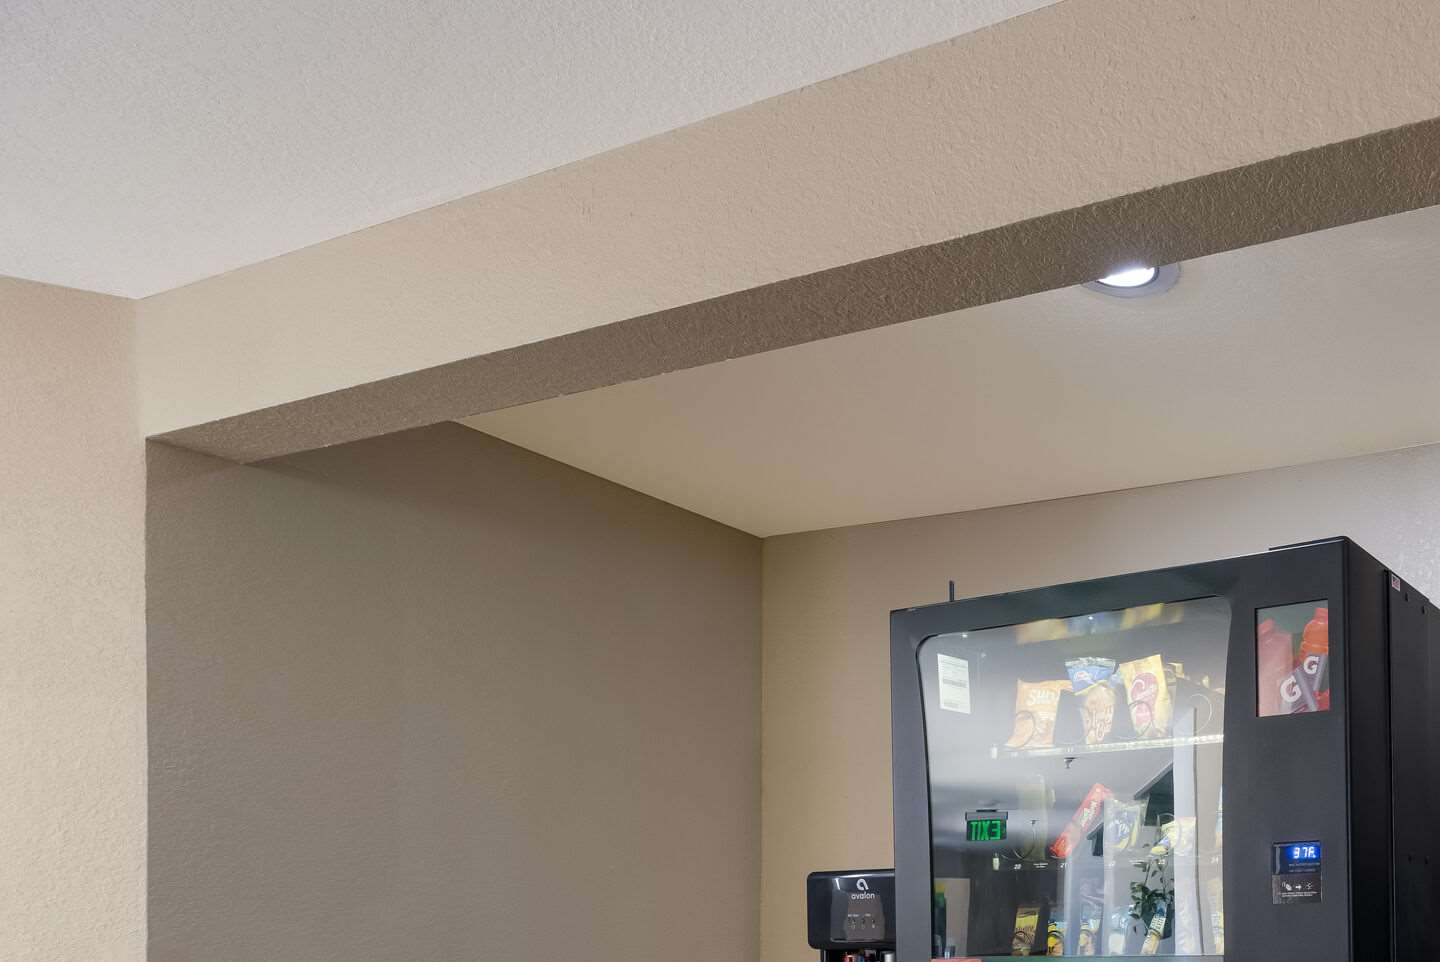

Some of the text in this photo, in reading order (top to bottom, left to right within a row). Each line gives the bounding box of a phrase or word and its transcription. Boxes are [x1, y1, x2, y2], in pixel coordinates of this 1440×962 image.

[1303, 655, 1320, 675] G
[1280, 675, 1302, 702] G
[850, 891, 876, 900] avalon
